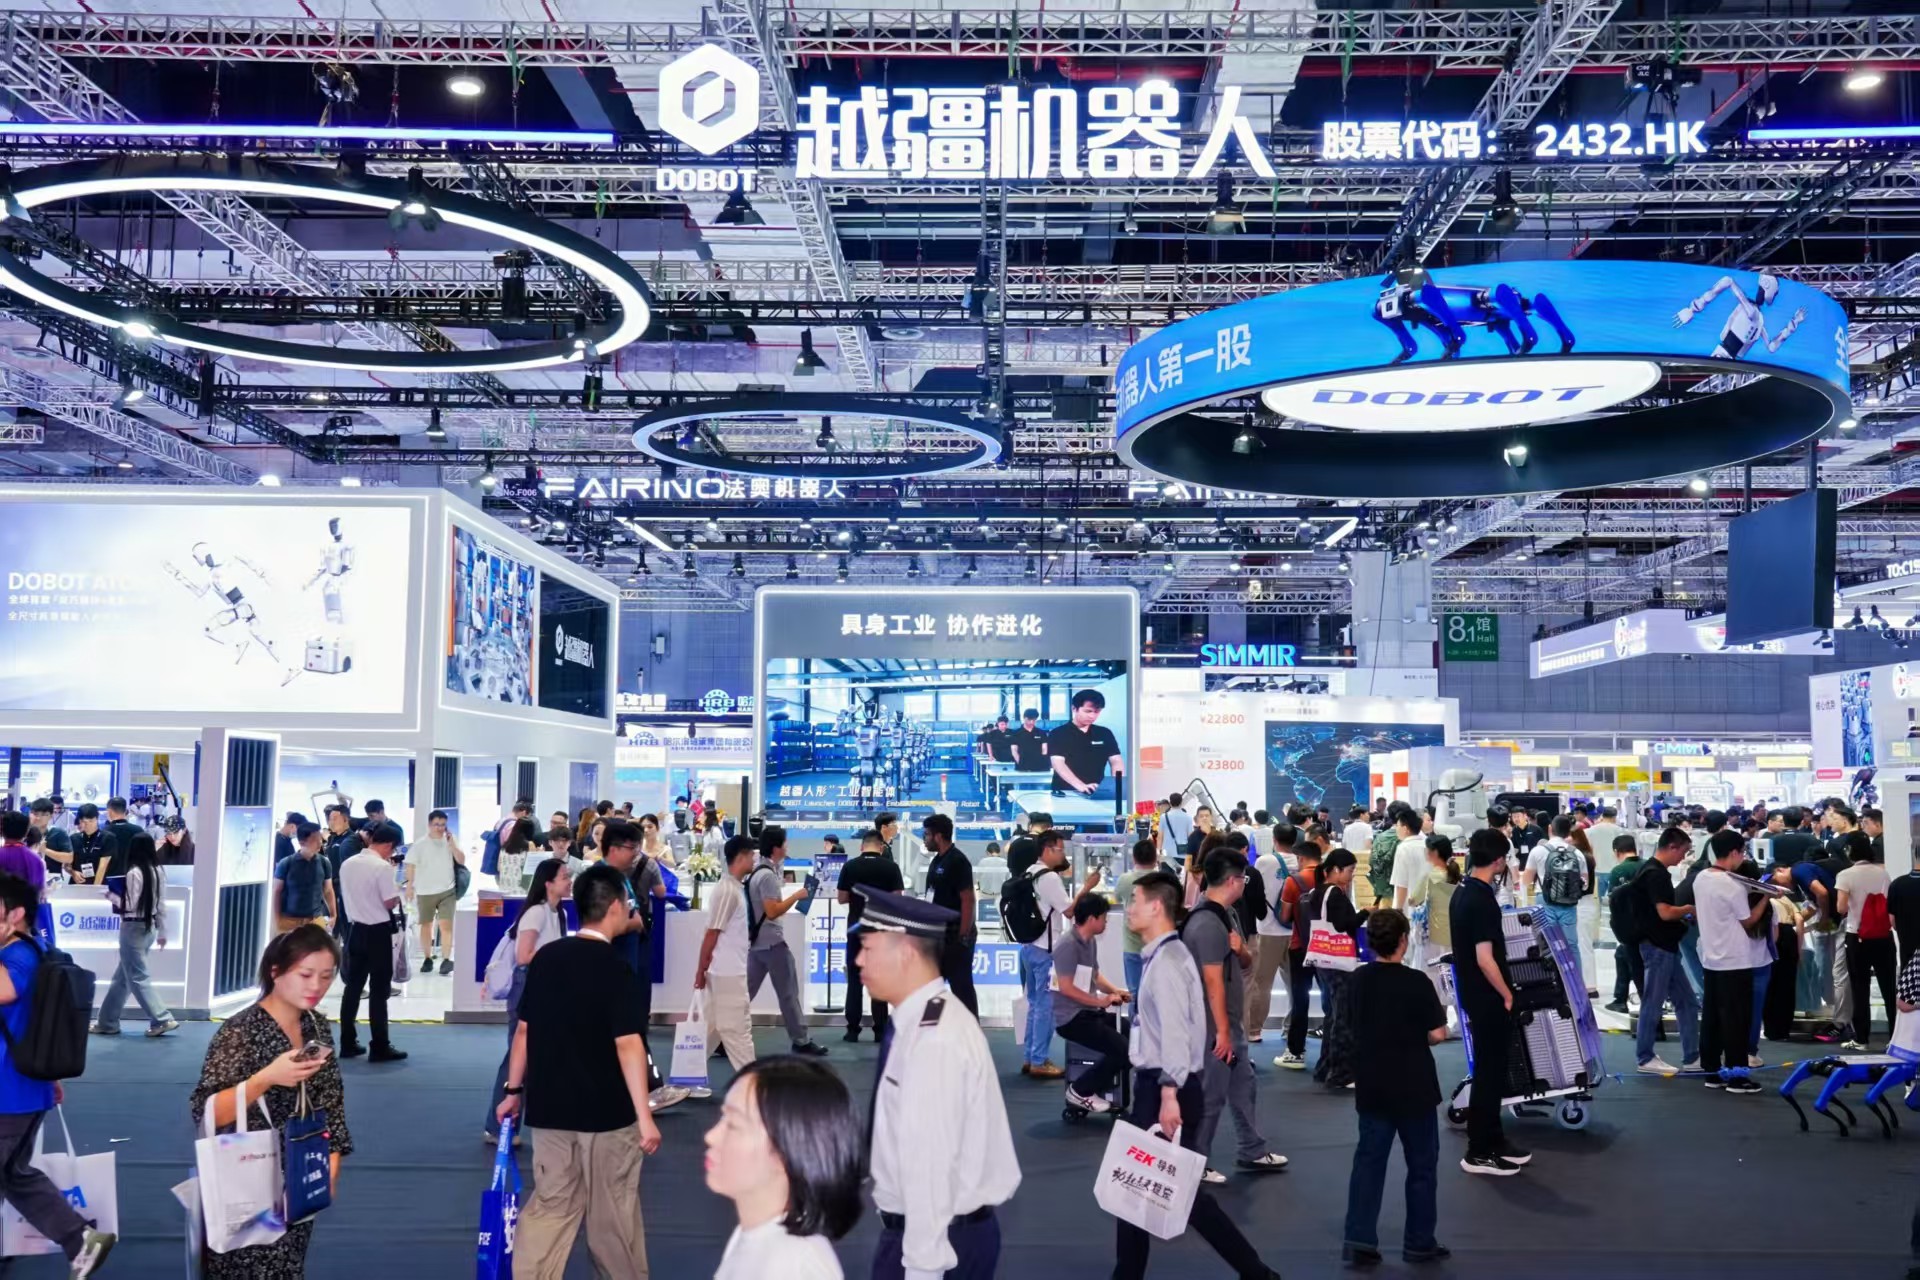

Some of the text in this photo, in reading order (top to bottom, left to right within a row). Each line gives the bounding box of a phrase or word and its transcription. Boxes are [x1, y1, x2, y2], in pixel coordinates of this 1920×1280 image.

[796, 85, 1277, 179] 越疆机器人
[1534, 120, 1708, 157] 2432.HK
[656, 169, 757, 192] DOBOT
[1312, 385, 1605, 405] DOBOT
[503, 488, 537, 497] No.F006
[545, 478, 846, 499] FAIRINO 法奥机器人
[8, 573, 86, 590] DOBOT
[840, 613, 1043, 636] 具身工业 协作进化
[1449, 616, 1491, 642] 8.1 馆
[1477, 634, 1494, 642] Hall
[1201, 644, 1297, 666] SiMMIR
[699, 699, 735, 707] HRB
[664, 737, 752, 747] 哈尔滨轴承集团有限公
[1127, 1145, 1158, 1167] FEK
